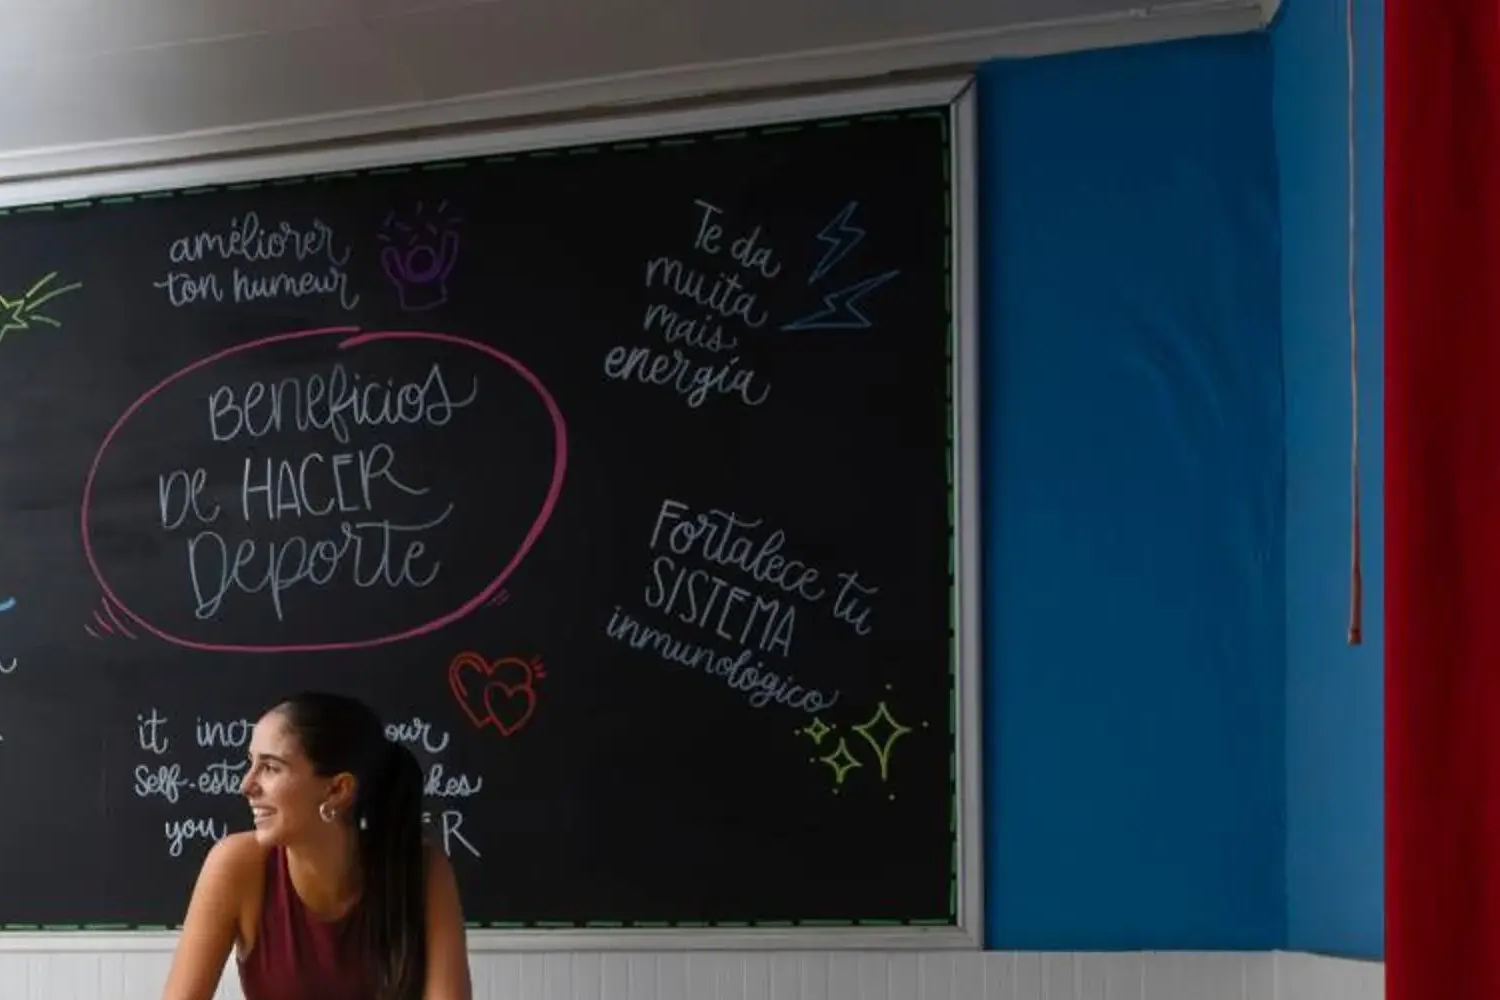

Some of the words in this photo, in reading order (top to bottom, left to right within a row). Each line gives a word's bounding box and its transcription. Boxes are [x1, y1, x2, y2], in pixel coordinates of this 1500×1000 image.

[694, 198, 723, 254] Te
[731, 225, 781, 279] da
[153, 271, 224, 307] ton
[233, 264, 360, 310] humeur
[645, 256, 768, 328] muita
[643, 302, 738, 352] mais
[242, 444, 430, 521] HACER
[188, 502, 455, 621] Deporte
[649, 498, 826, 601] Fortalece
[644, 556, 797, 658] SISTEMA
[137, 706, 169, 755] it
[383, 715, 450, 754] our
[163, 816, 228, 858] you
